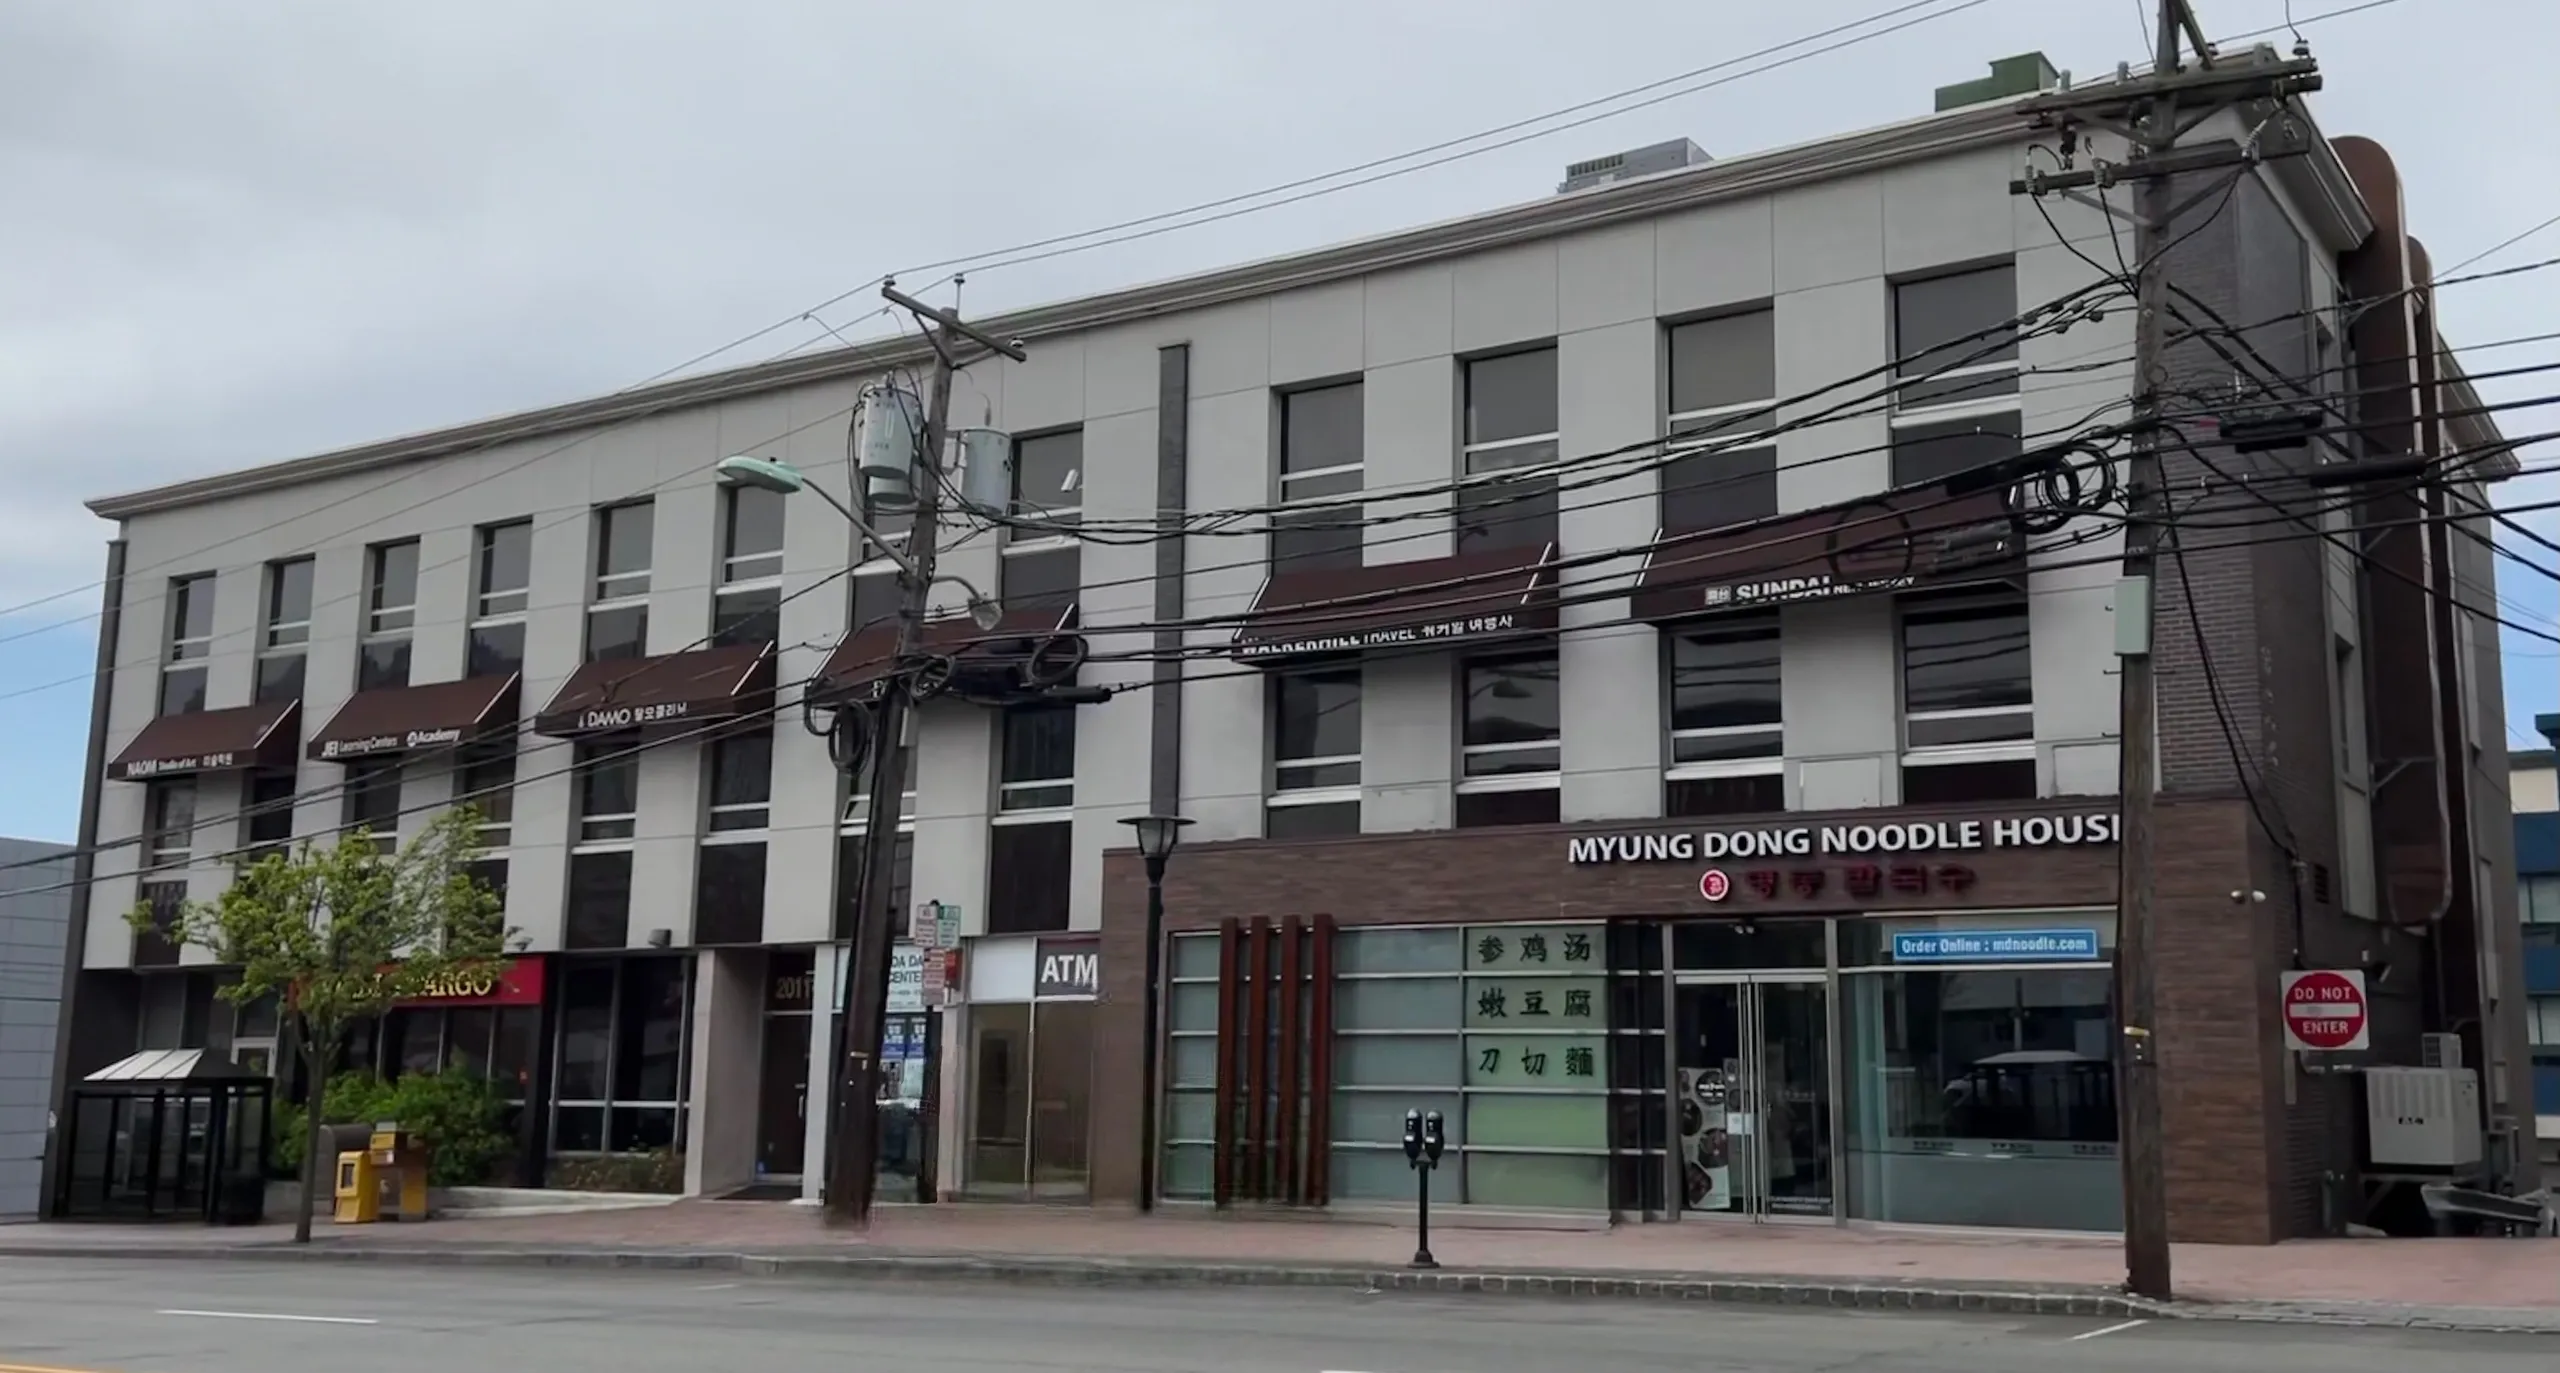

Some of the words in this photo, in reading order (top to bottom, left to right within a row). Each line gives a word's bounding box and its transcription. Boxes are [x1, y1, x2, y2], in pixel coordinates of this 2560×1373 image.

[587, 708, 631, 727] DAMO
[1568, 834, 1693, 863] MYUNG
[1704, 828, 1809, 857] DONG
[1821, 820, 1982, 853] NOODLE
[1478, 933, 1591, 964] 参鸡汤
[1902, 939, 1937, 953] Order
[1940, 938, 1981, 953] Online
[1993, 936, 2087, 950] mdnoodle.com
[889, 970, 922, 984] CENTE
[1041, 954, 1098, 990] ATM
[2294, 987, 2315, 1000] DO
[2322, 986, 2352, 1000] NOT
[1478, 988, 1591, 1018] 嫩豆腐
[2302, 1021, 2349, 1034] ENTER
